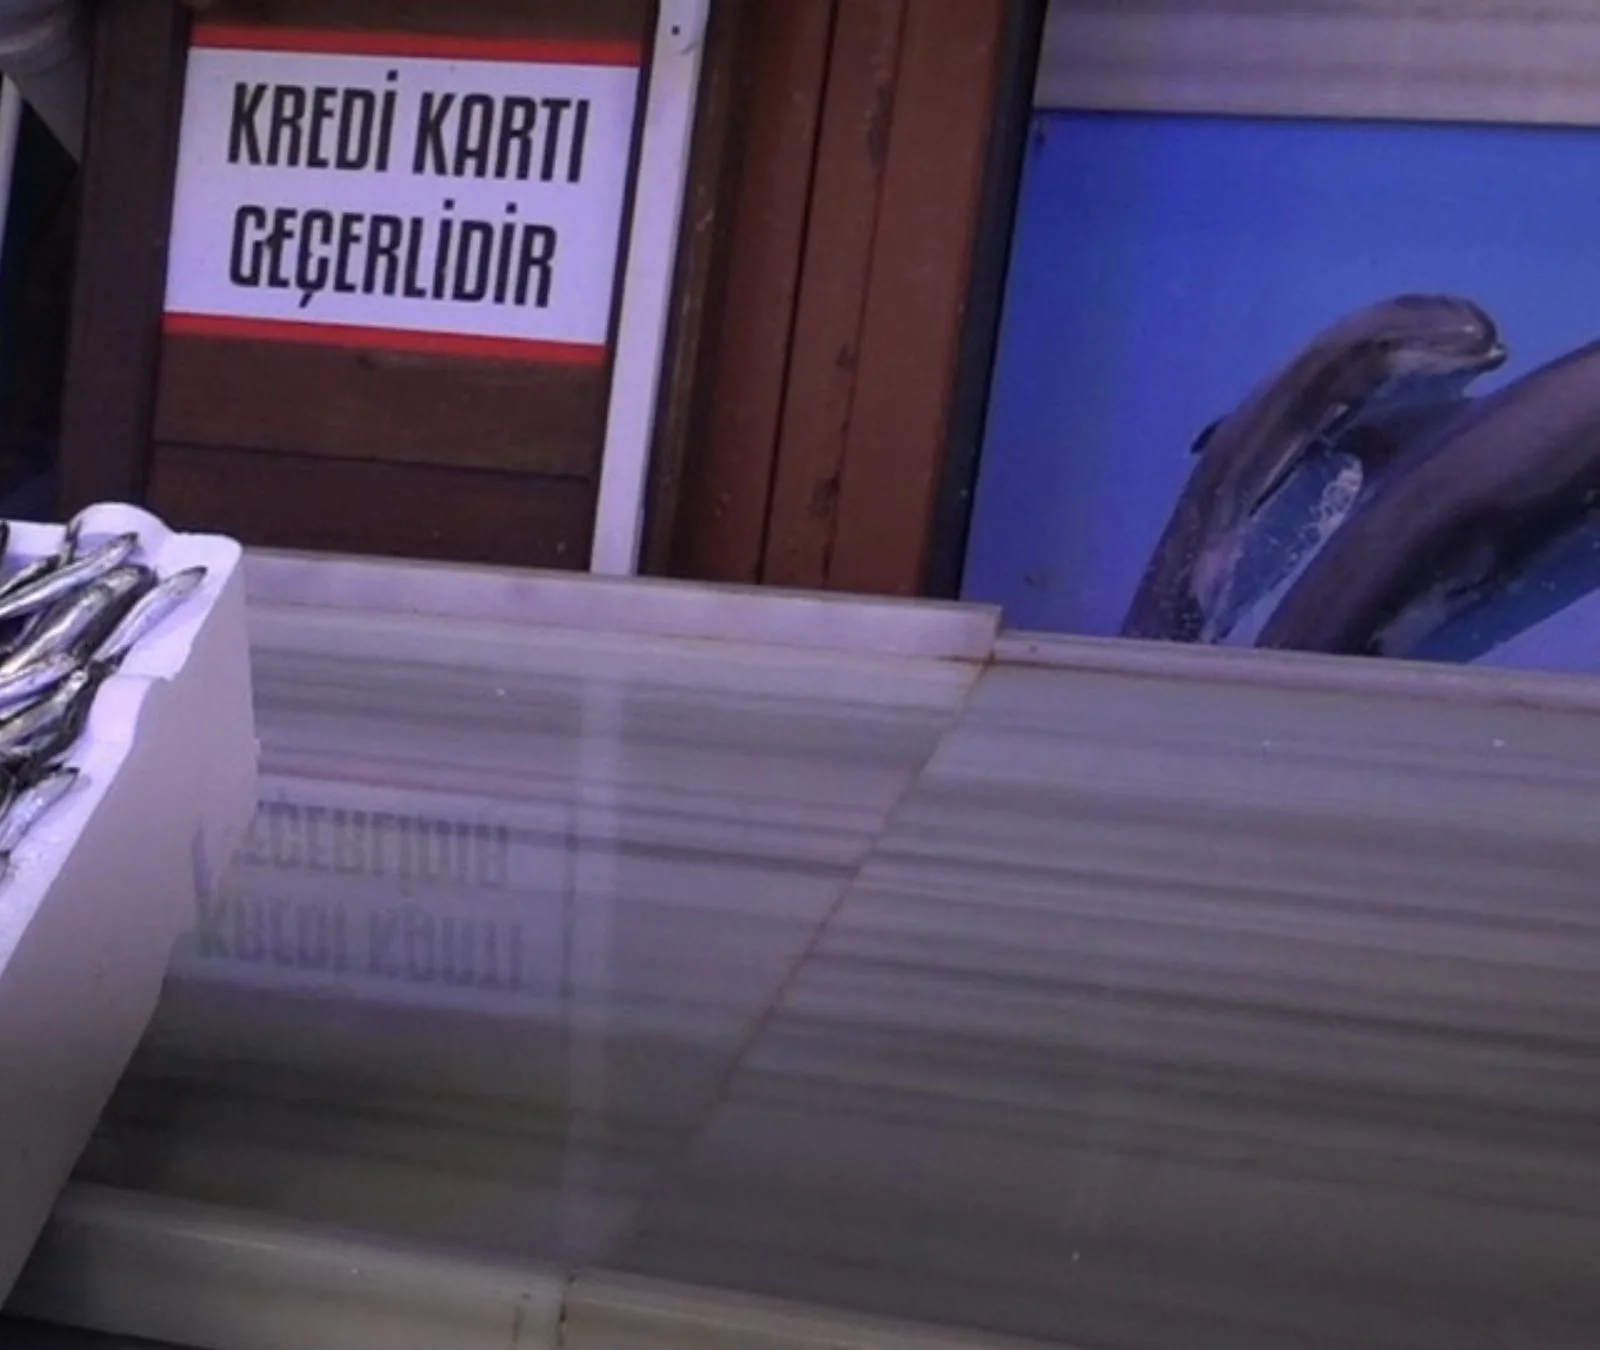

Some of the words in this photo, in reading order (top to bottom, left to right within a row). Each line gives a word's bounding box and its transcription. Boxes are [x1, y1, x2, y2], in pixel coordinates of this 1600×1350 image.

[227, 69, 399, 174] KREDİ
[412, 90, 590, 184] KARTI
[229, 199, 557, 309] GEÇERLİDİR
